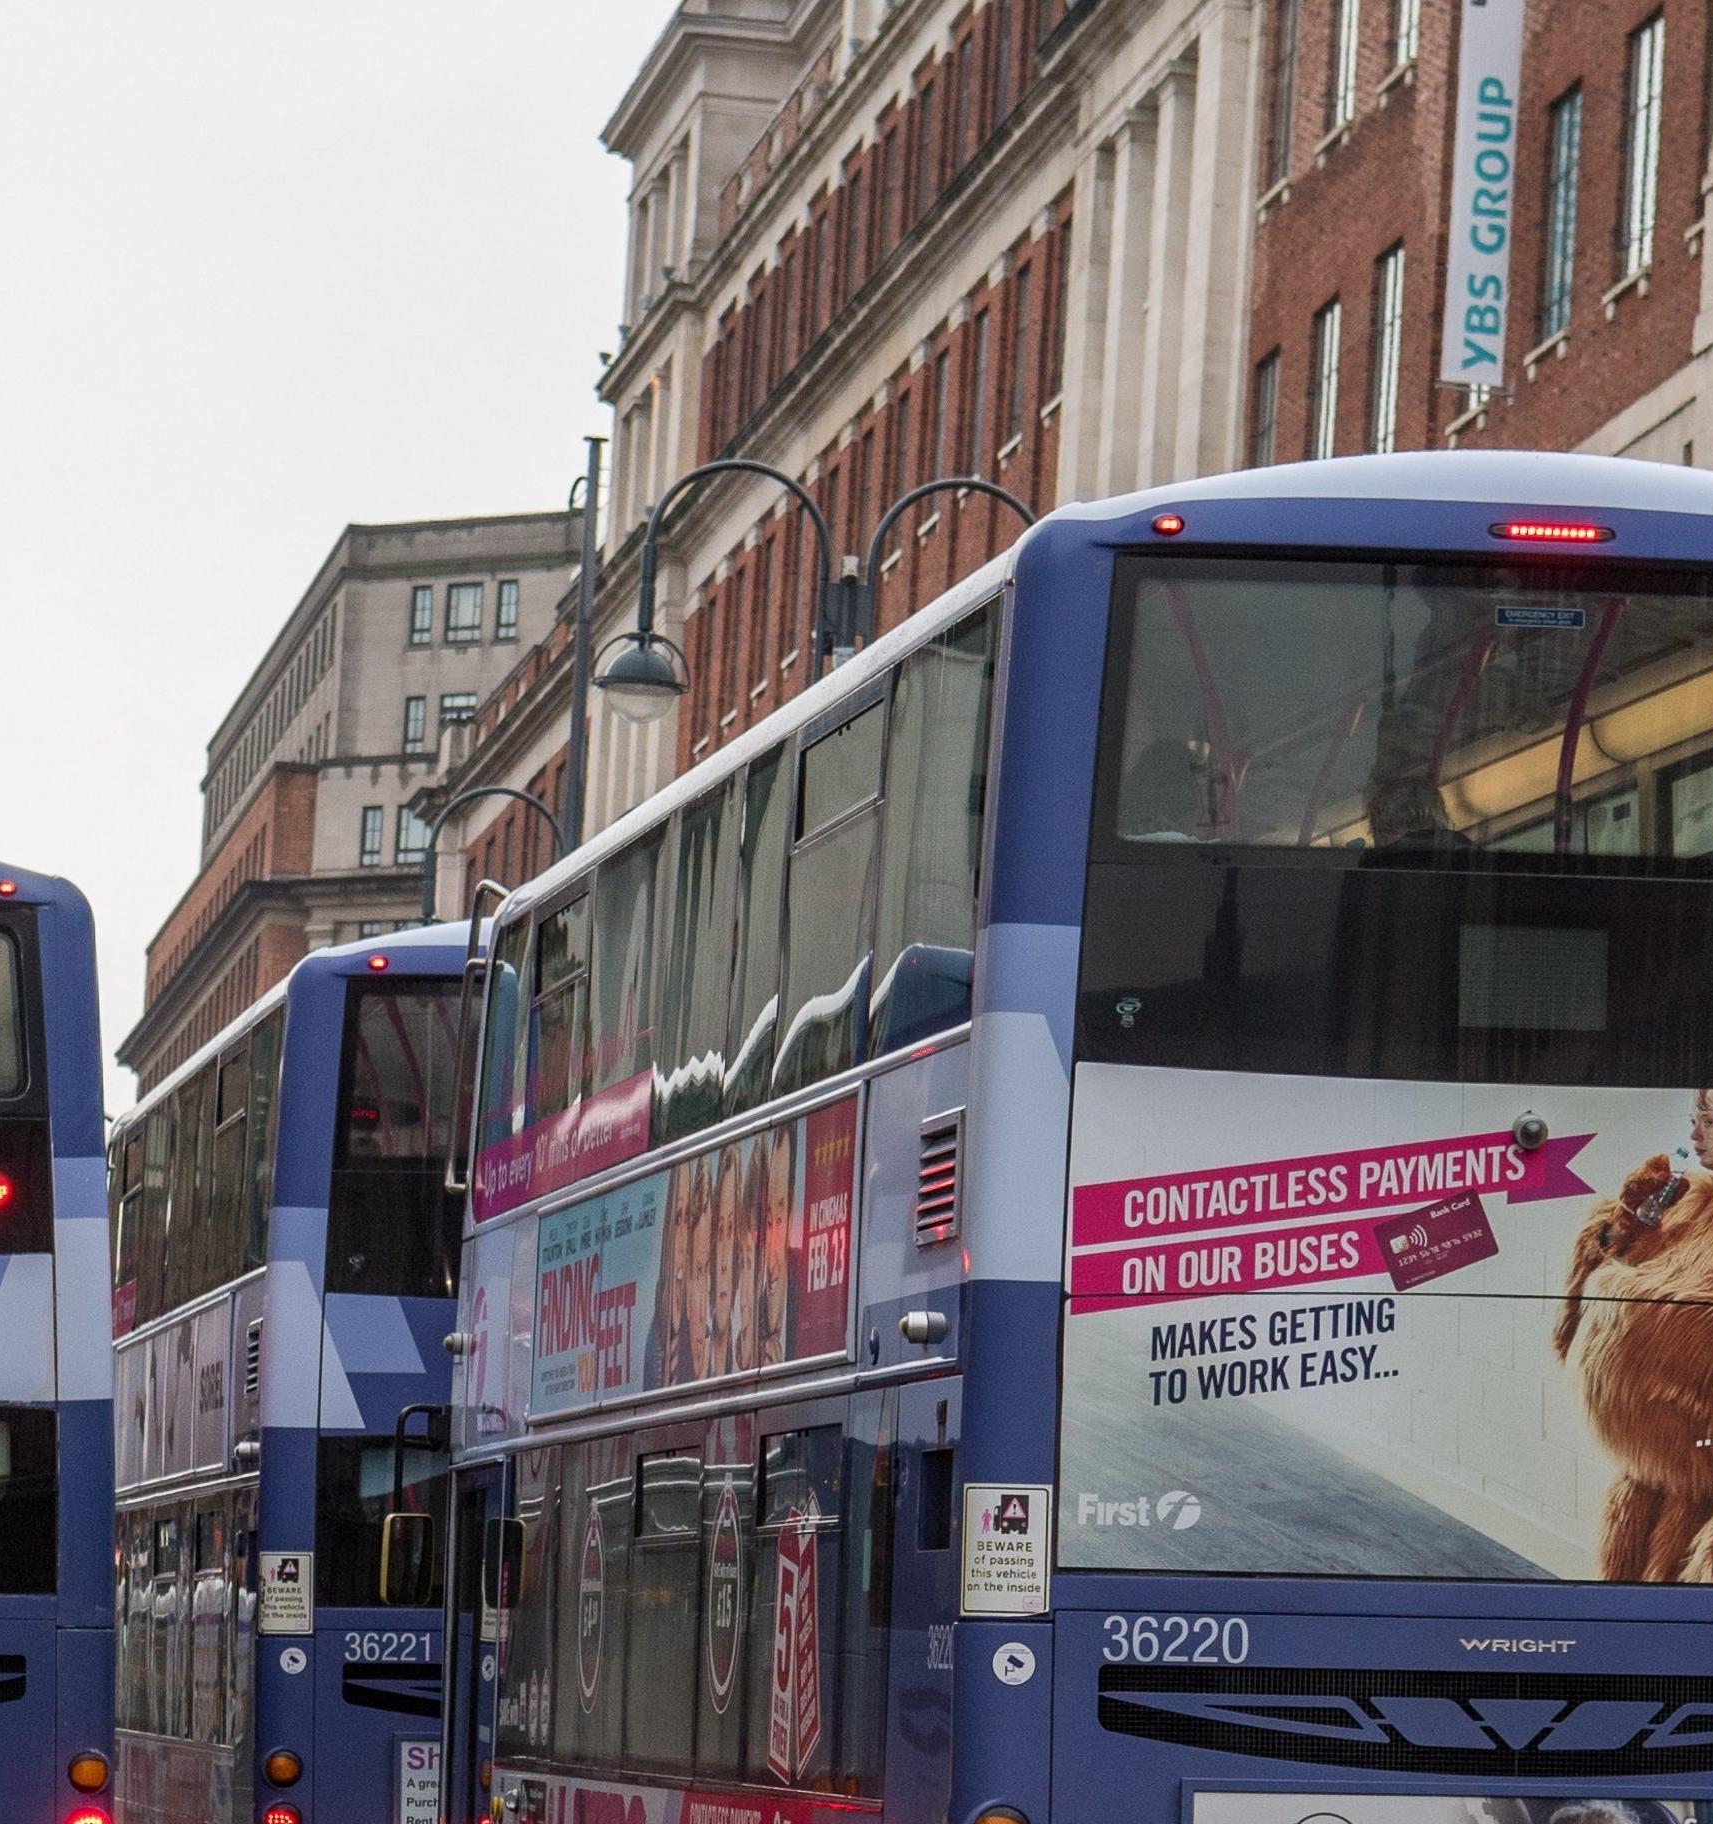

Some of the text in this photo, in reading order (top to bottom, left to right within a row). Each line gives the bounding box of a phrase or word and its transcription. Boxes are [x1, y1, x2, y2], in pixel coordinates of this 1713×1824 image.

[1460, 76, 1514, 370] YBS GROUP
[497, 1150, 535, 1193] to every
[1124, 1143, 1526, 1229] CONTACTLESS PAYMENTS
[810, 1192, 848, 1234] IN CINEMAS
[1429, 1197, 1471, 1220] Bank Card
[807, 1226, 846, 1293] FEB 23
[1122, 1230, 1360, 1296] ON OUR BUSES
[539, 1252, 600, 1359] FINDING
[596, 1281, 637, 1391] FEET
[1150, 1297, 1397, 1362] MAKES GETTING
[1149, 1344, 1400, 1407] TO WORK EASY...
[1077, 1492, 1151, 1527] First
[974, 1554, 1035, 1568] of passing
[977, 1541, 1033, 1553] BEWARE
[967, 1581, 1041, 1593] on the inside
[971, 1567, 1037, 1580] this vehicle
[344, 1632, 431, 1662] 36221
[1102, 1617, 1250, 1665] 36220
[1458, 1637, 1576, 1655] WRIGHT
[406, 1778, 416, 1789] A
